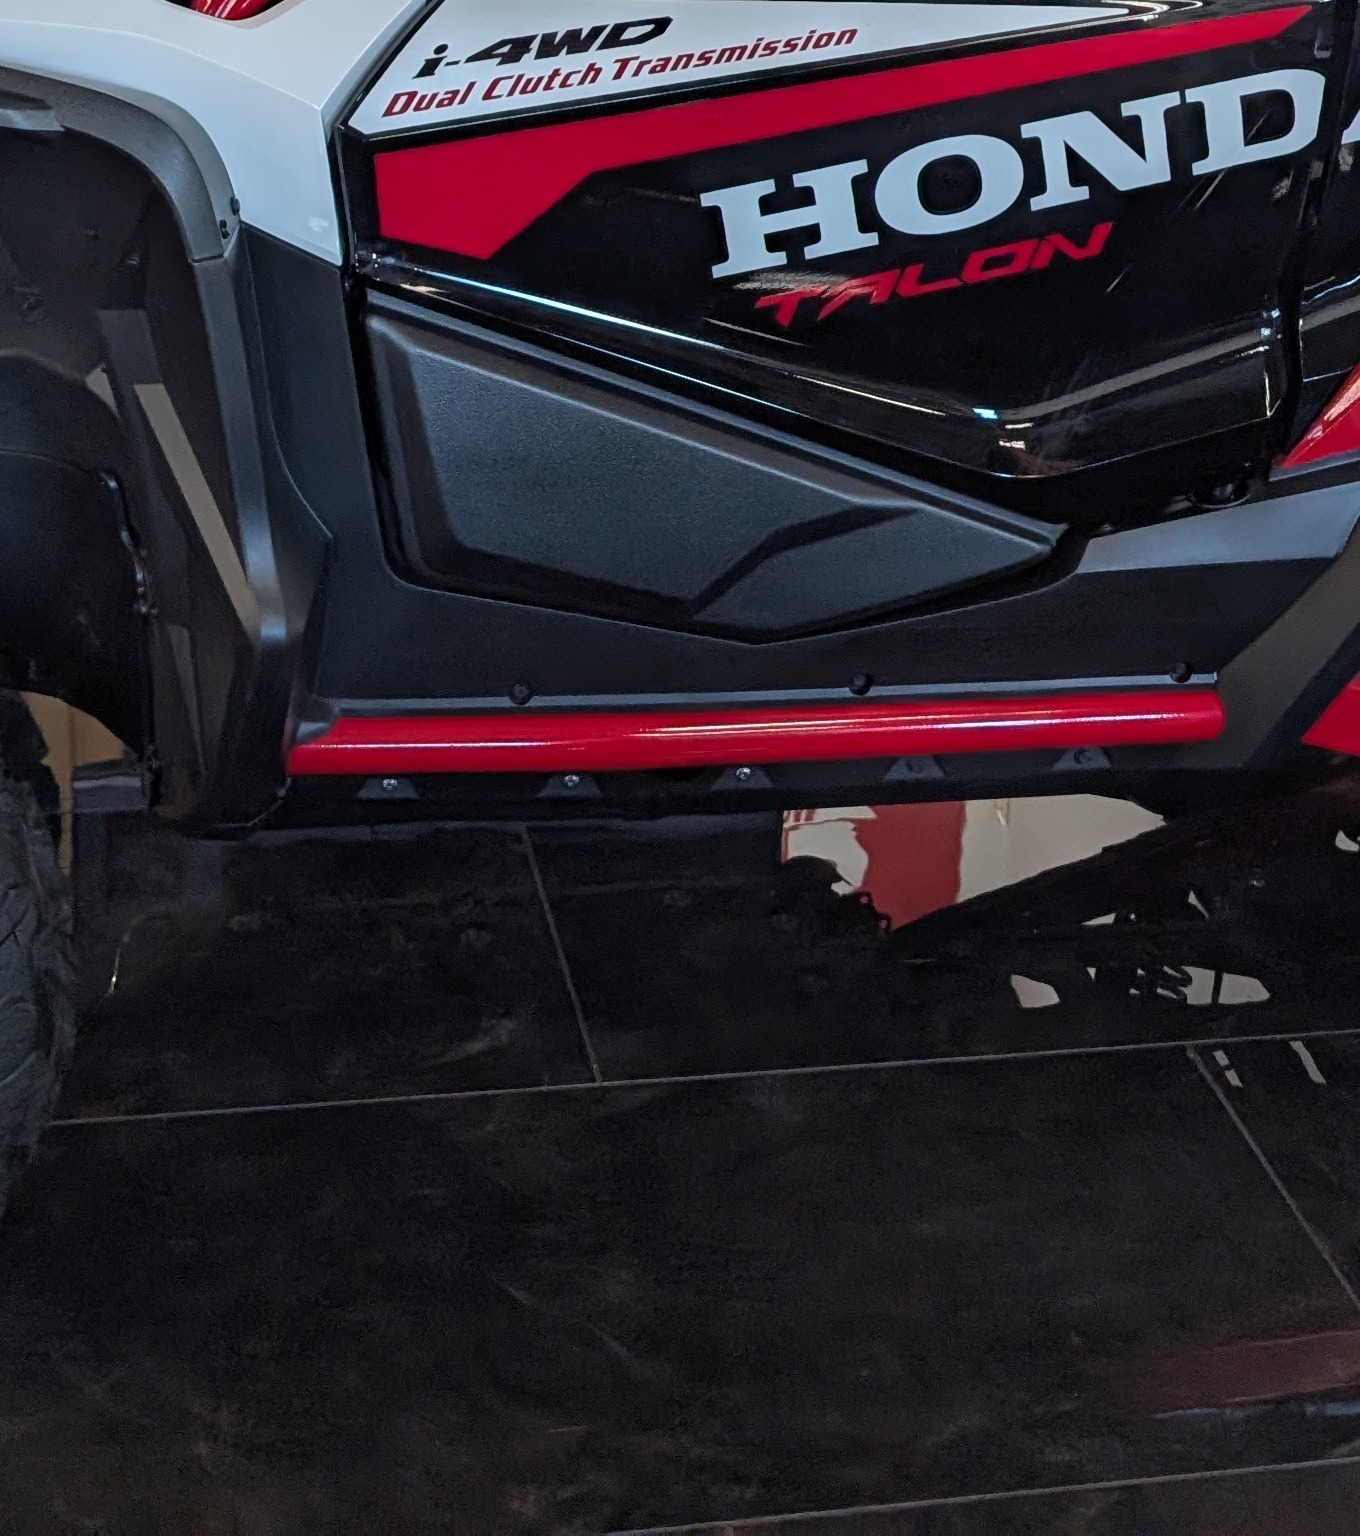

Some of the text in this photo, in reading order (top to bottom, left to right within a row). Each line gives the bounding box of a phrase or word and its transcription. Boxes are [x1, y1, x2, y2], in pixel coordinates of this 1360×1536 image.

[380, 27, 859, 122] Dual Clutch Transmission
[414, 15, 674, 81] i-4WD
[753, 221, 1115, 328] TALON
